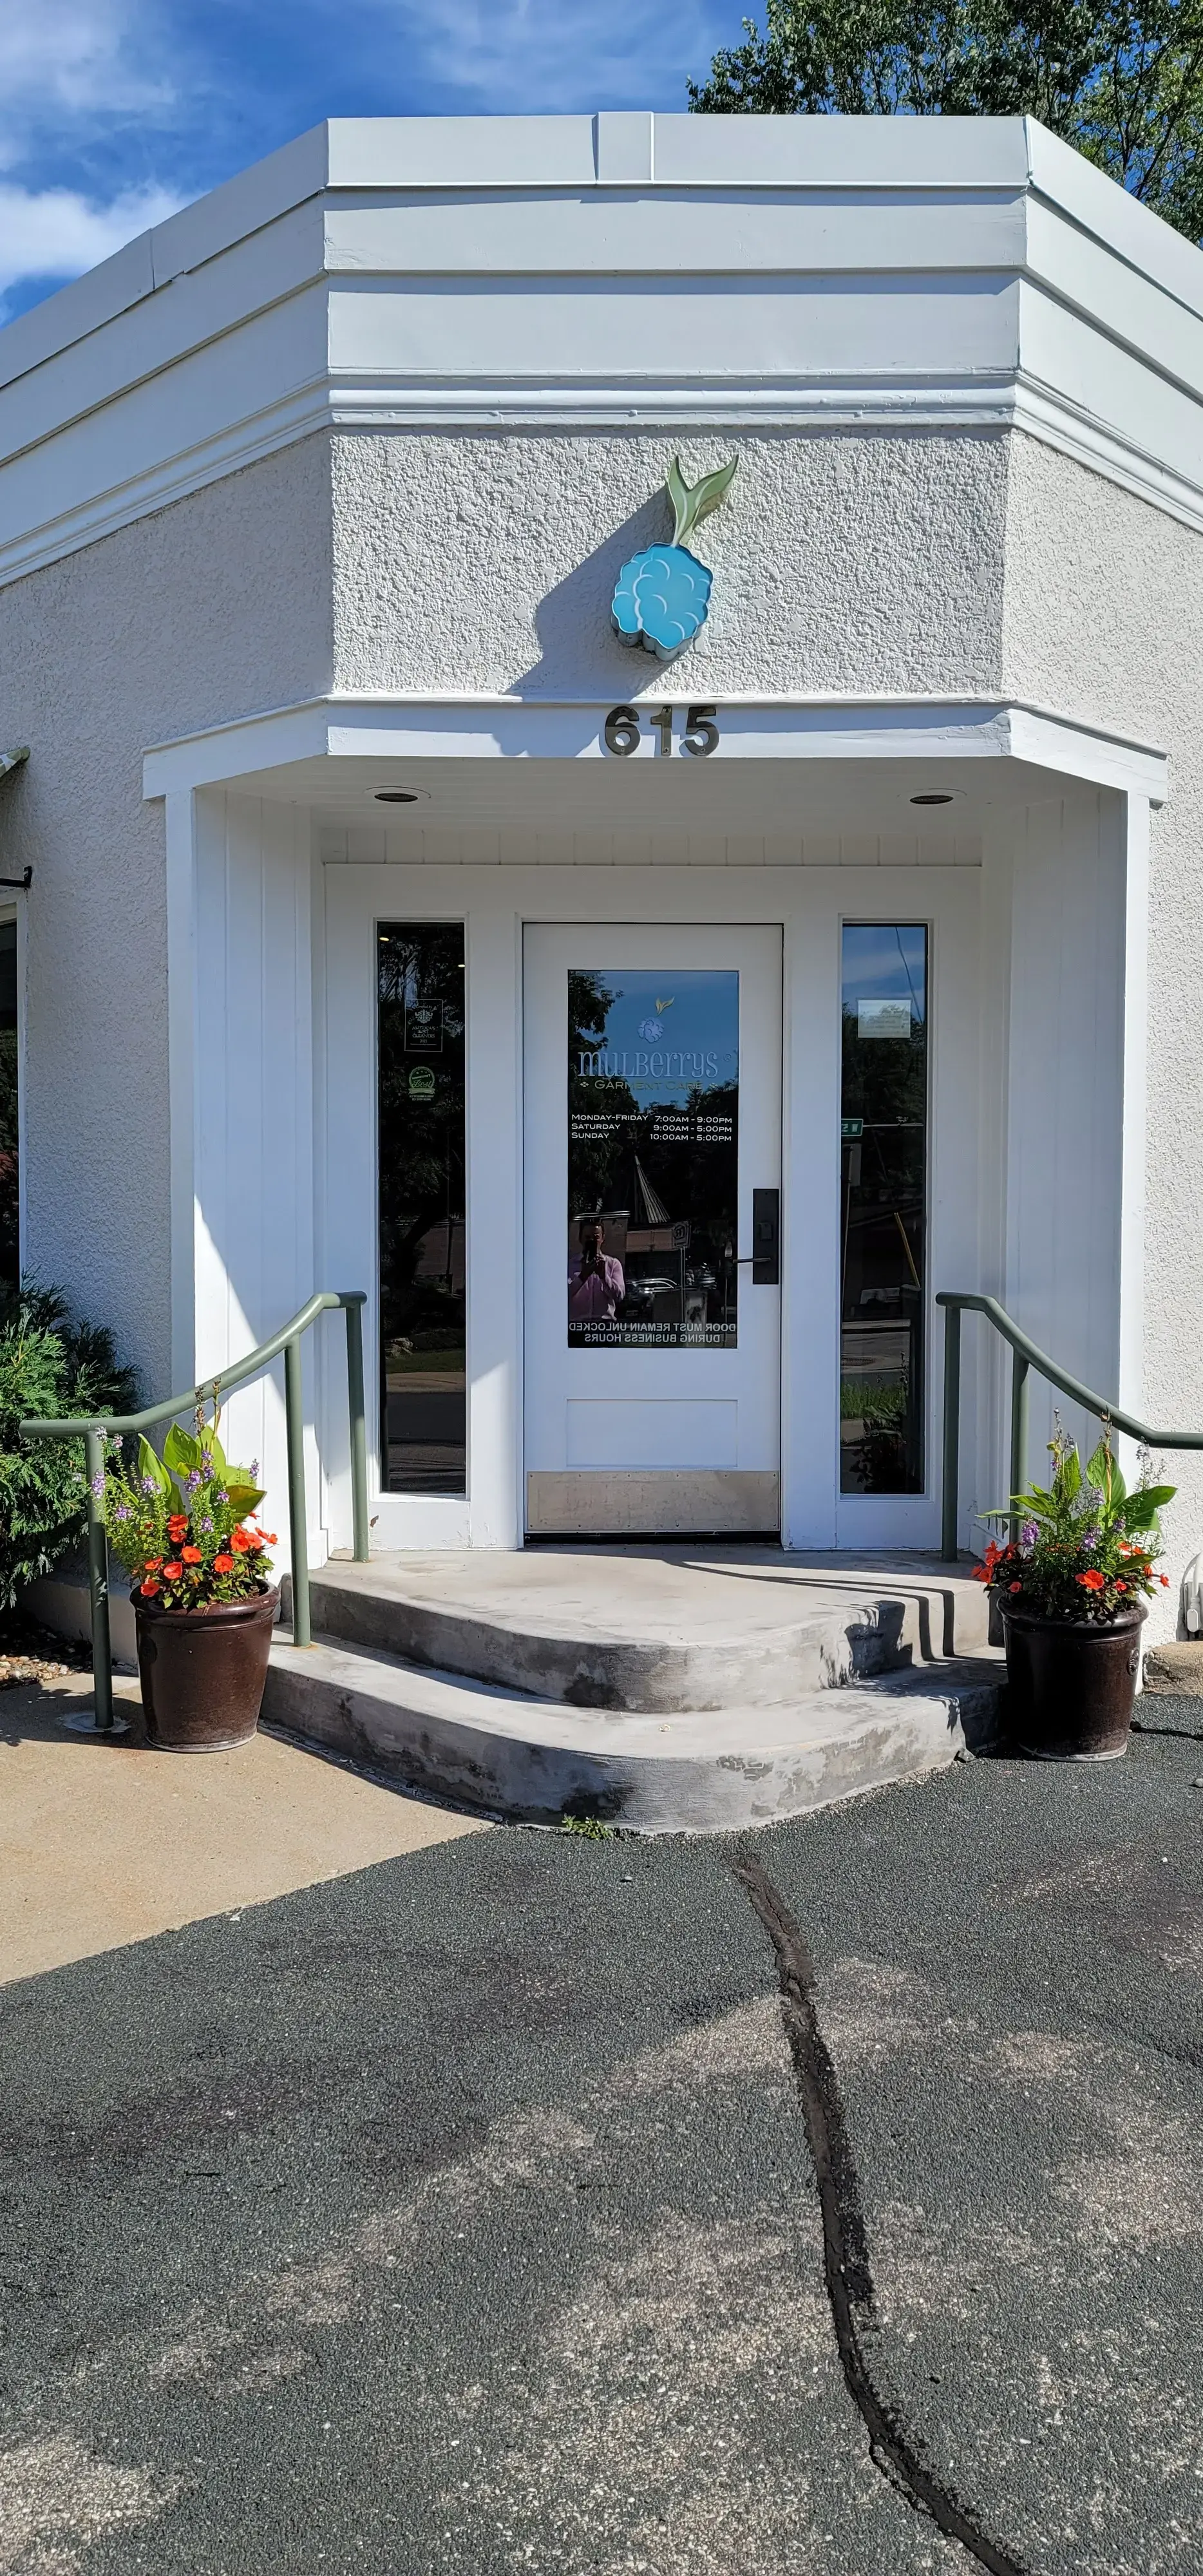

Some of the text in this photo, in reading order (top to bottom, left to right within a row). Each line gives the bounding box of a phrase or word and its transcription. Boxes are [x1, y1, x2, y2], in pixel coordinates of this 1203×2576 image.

[605, 706, 720, 755] 615
[594, 1079, 703, 1091] GARMENT CARE
